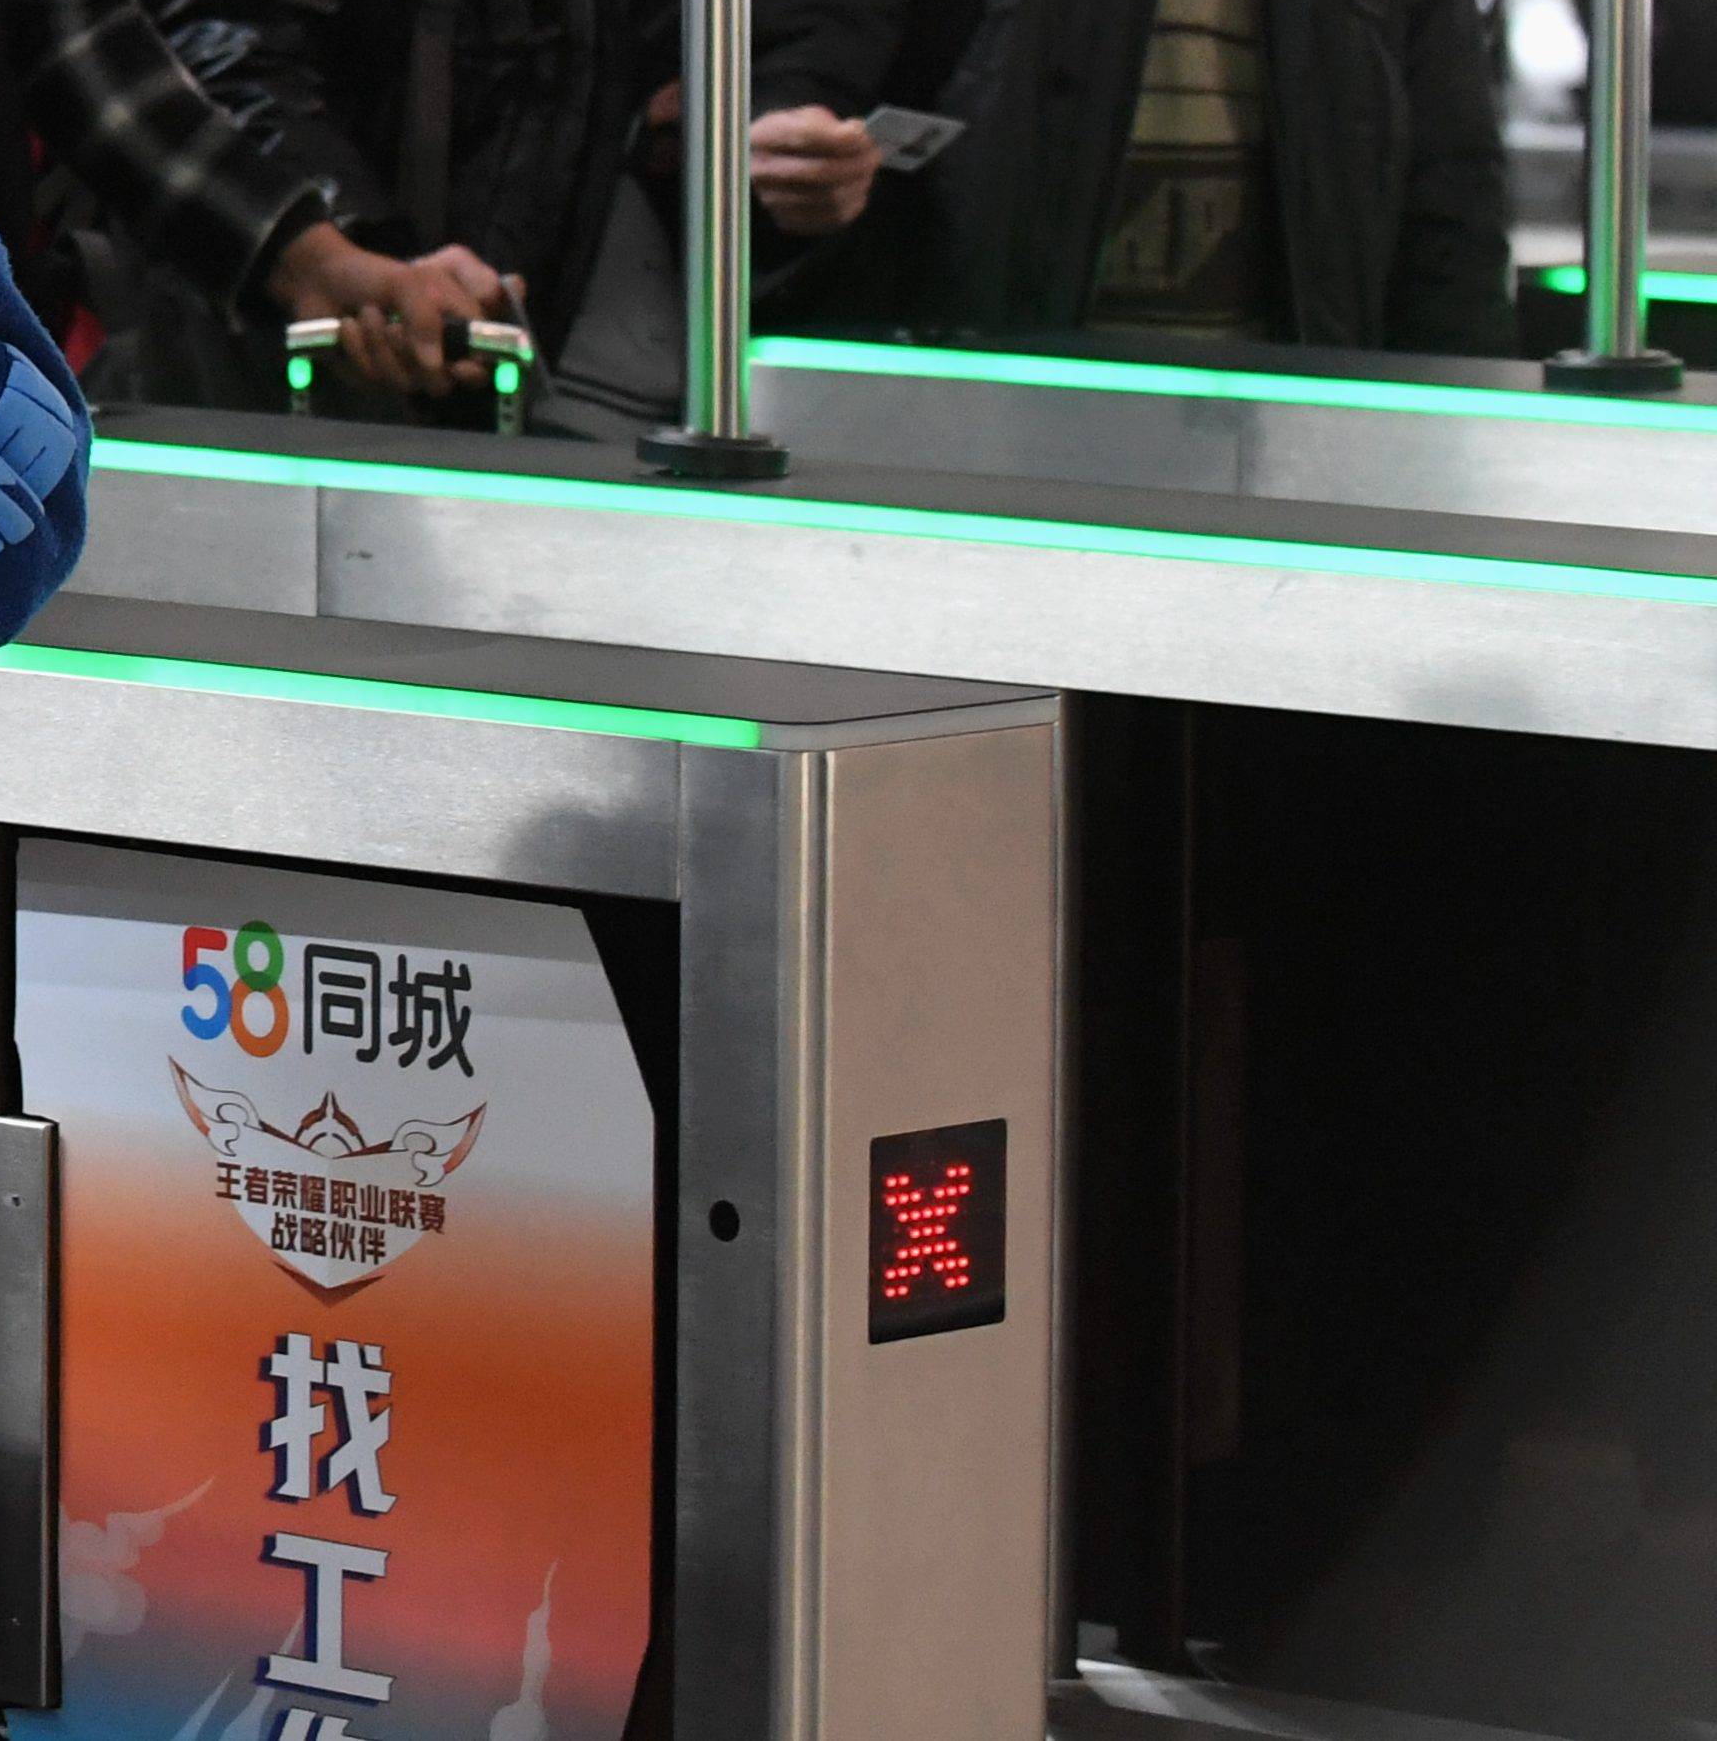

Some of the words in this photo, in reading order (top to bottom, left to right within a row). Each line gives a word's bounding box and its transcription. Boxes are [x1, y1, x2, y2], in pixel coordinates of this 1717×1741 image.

[215, 1161, 446, 1235] 王者荣耀职业联赛
[270, 1211, 388, 1265] 战略伙伴
[260, 1330, 399, 1741] 找工
